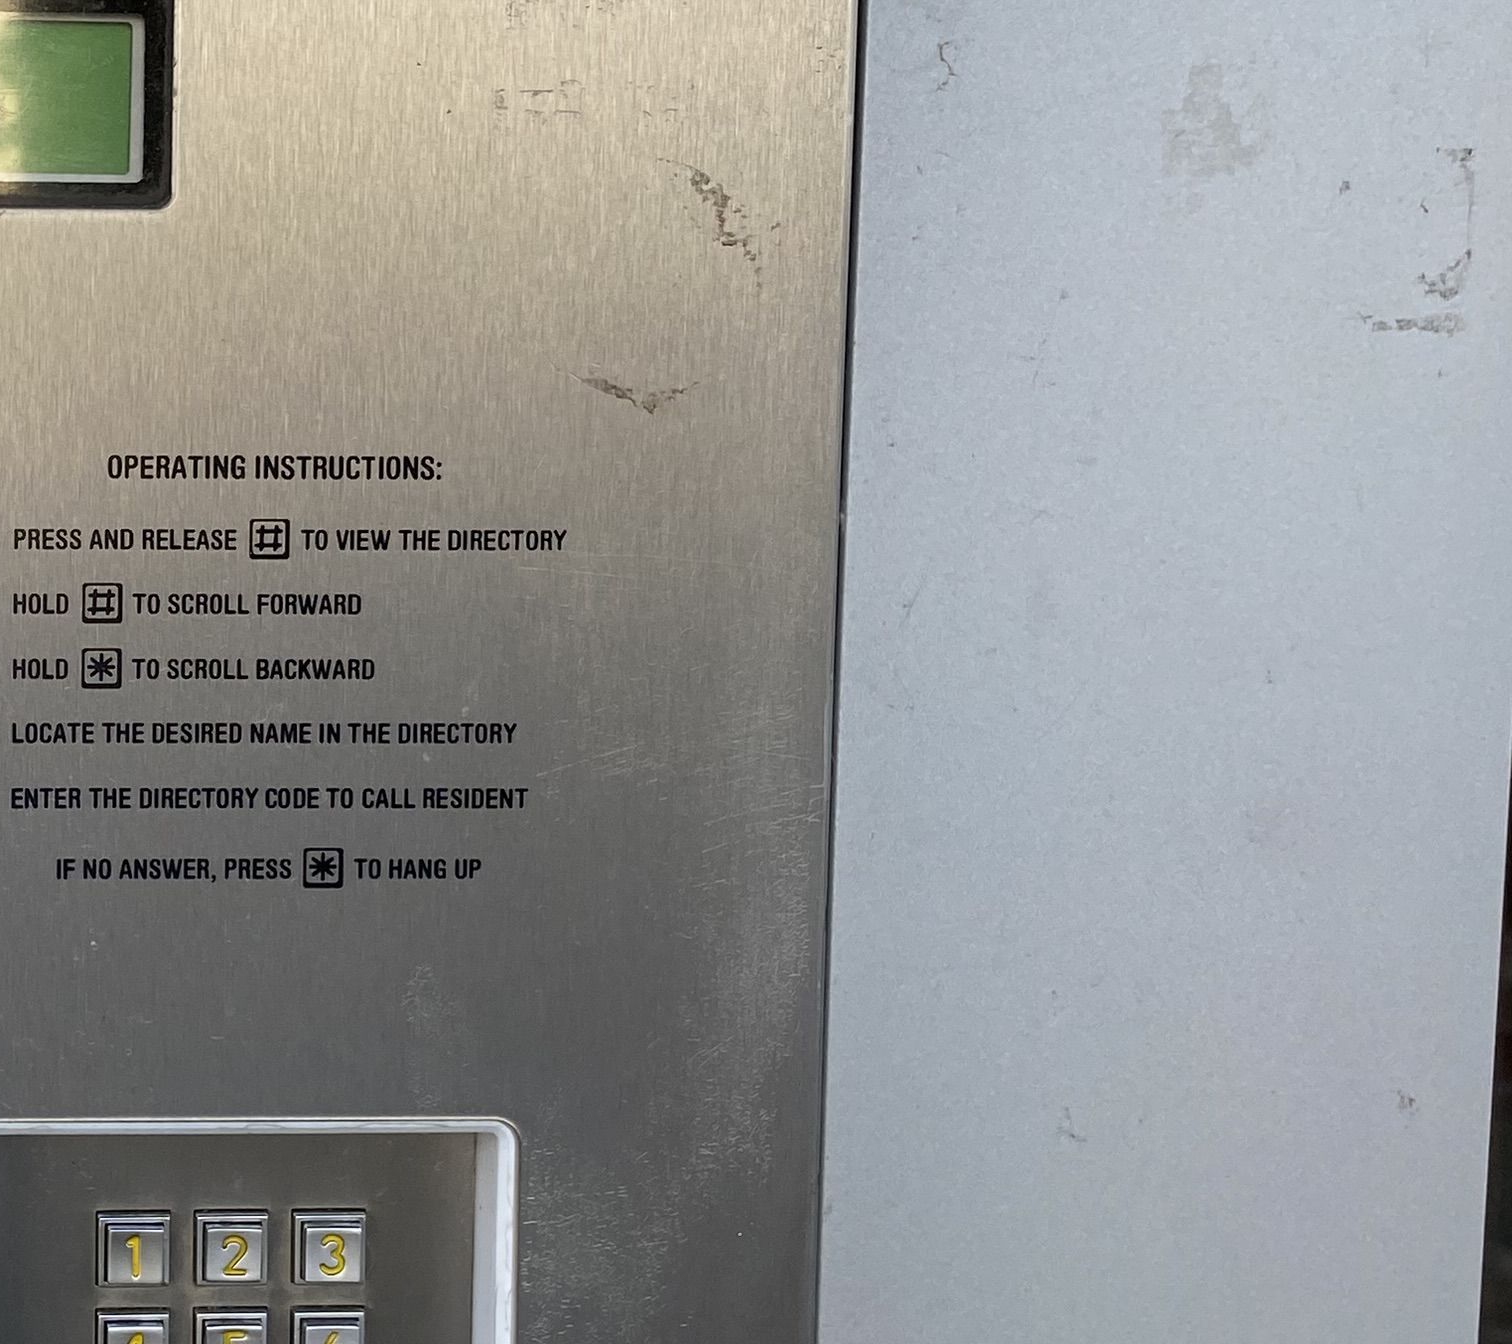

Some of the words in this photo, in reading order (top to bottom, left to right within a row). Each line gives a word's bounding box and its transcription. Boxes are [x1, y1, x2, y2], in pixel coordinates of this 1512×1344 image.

[107, 454, 246, 480] OPERATING
[254, 454, 443, 481] INSTRUCTIONS:
[13, 528, 82, 550] PRESS
[89, 528, 135, 550] AND
[142, 528, 237, 551] RELEASE
[300, 528, 329, 551] TO
[335, 529, 392, 551] VIEW
[398, 529, 441, 551] THE
[447, 529, 568, 552] DIRECTORY
[13, 593, 69, 615] HOLD
[132, 593, 161, 615] TO
[167, 593, 250, 615] SCROLL
[257, 593, 362, 616] FORWARD
[12, 658, 69, 680] HOLD
[131, 658, 160, 680] TO
[166, 658, 249, 680] SCROLL
[255, 658, 376, 681] BACKWARD
[11, 722, 95, 744] LOCATE
[101, 722, 145, 744] THE
[151, 722, 243, 744] DESIRED
[250, 722, 312, 745] NAME
[318, 722, 341, 744] IN
[347, 722, 391, 745] THE
[397, 722, 518, 745] DIRECTORY
[10, 787, 81, 810] ENTER
[88, 787, 132, 809] THE
[139, 787, 259, 809] DIRECTORY
[264, 787, 320, 810] CODE
[325, 787, 354, 809] TO
[361, 787, 416, 809] CALL
[422, 787, 529, 810] RESIDENT
[56, 858, 76, 880] IF
[82, 858, 112, 880] NO
[118, 858, 217, 883] ANSWER,
[224, 857, 292, 880] PRESS
[353, 857, 382, 880] TO
[388, 858, 447, 880] HANG
[454, 858, 482, 880] UP
[123, 1234, 142, 1279] 1
[221, 1234, 248, 1277] 2
[318, 1233, 346, 1276] 3
